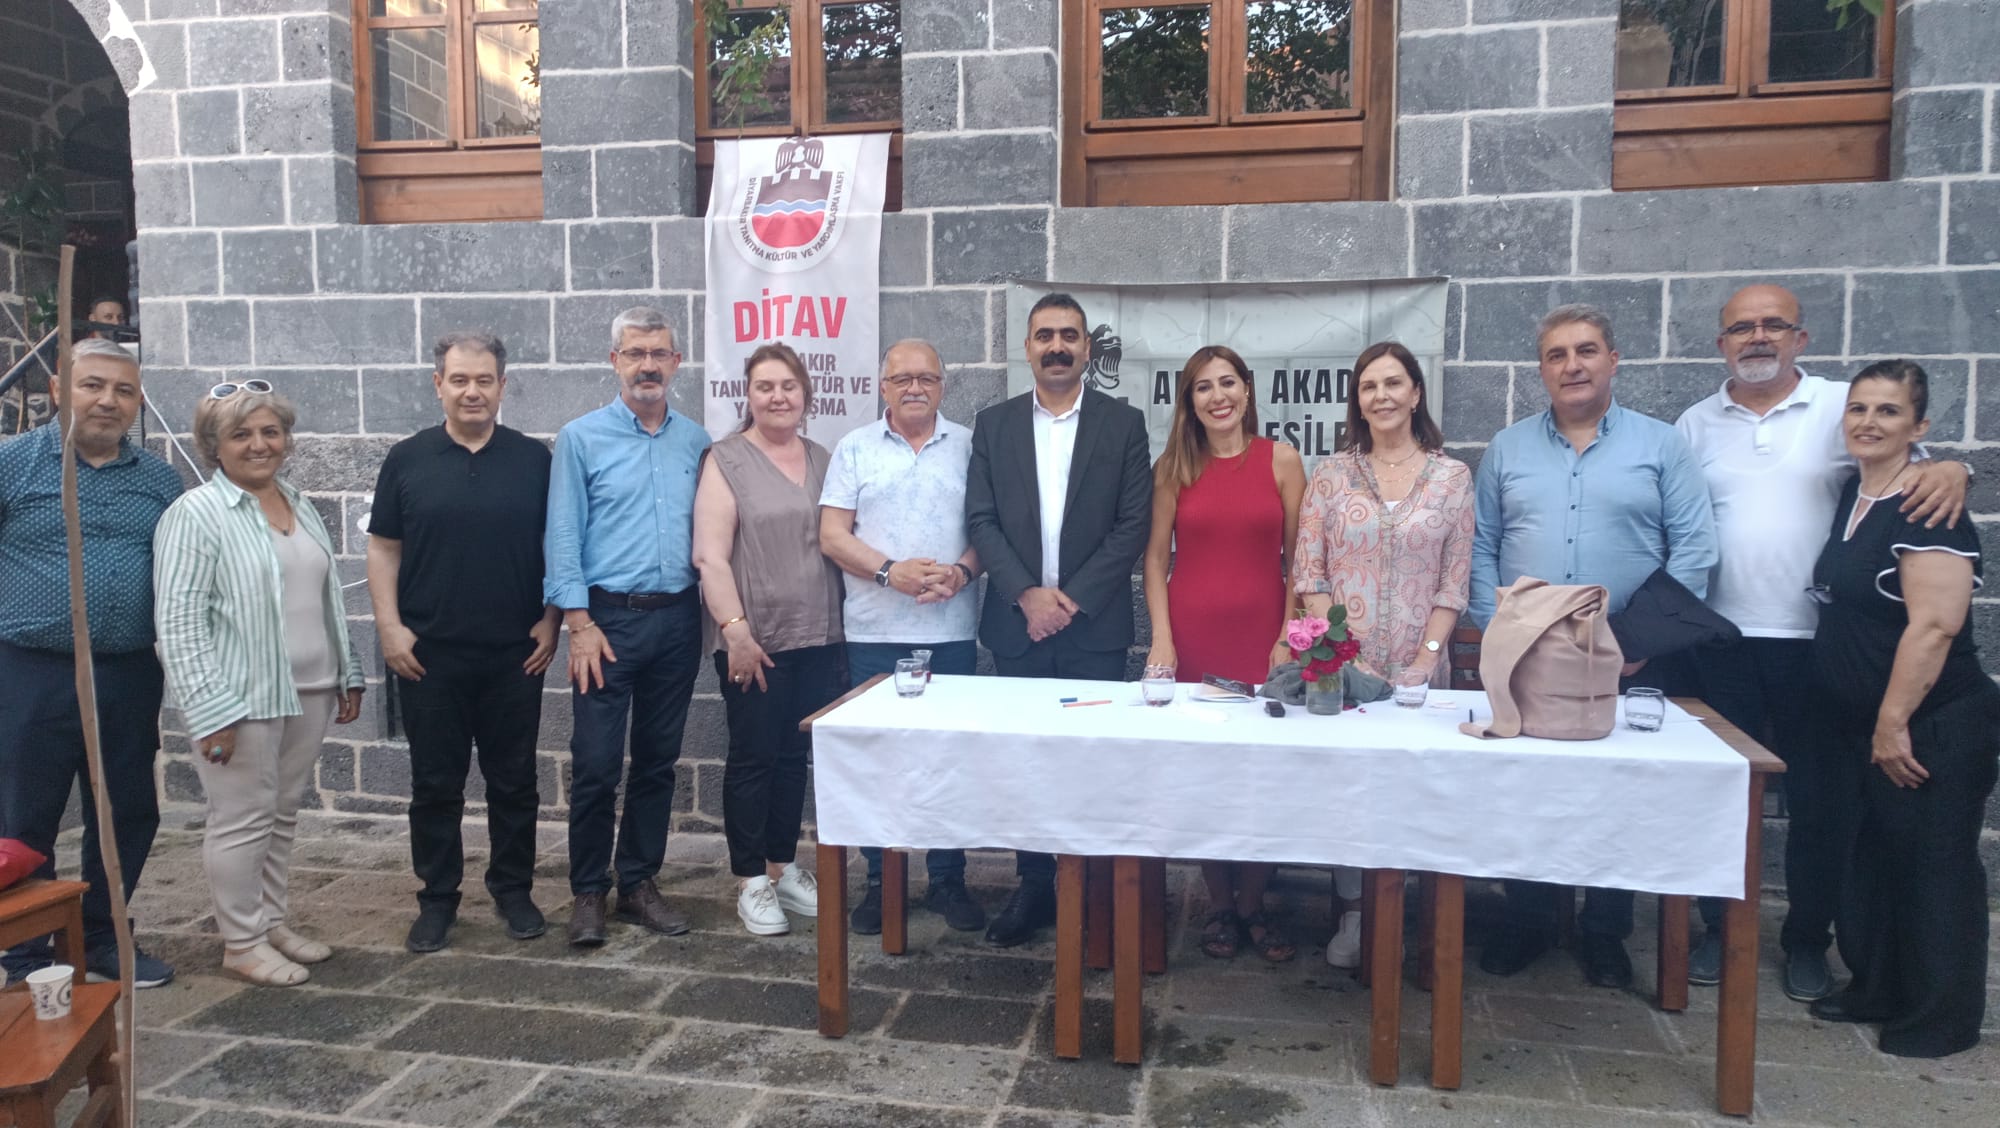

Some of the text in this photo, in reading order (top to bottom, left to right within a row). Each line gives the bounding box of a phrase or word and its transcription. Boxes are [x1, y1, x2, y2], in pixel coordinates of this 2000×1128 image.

[740, 224, 764, 258] TANITMA
[765, 250, 798, 262] KÜLTÜR
[801, 248, 813, 259] VE
[833, 171, 845, 195] VAKFI
[733, 288, 848, 343] DİTAV
[710, 371, 872, 398] TANI TÜR VE
[1271, 369, 1354, 404] AKAD
